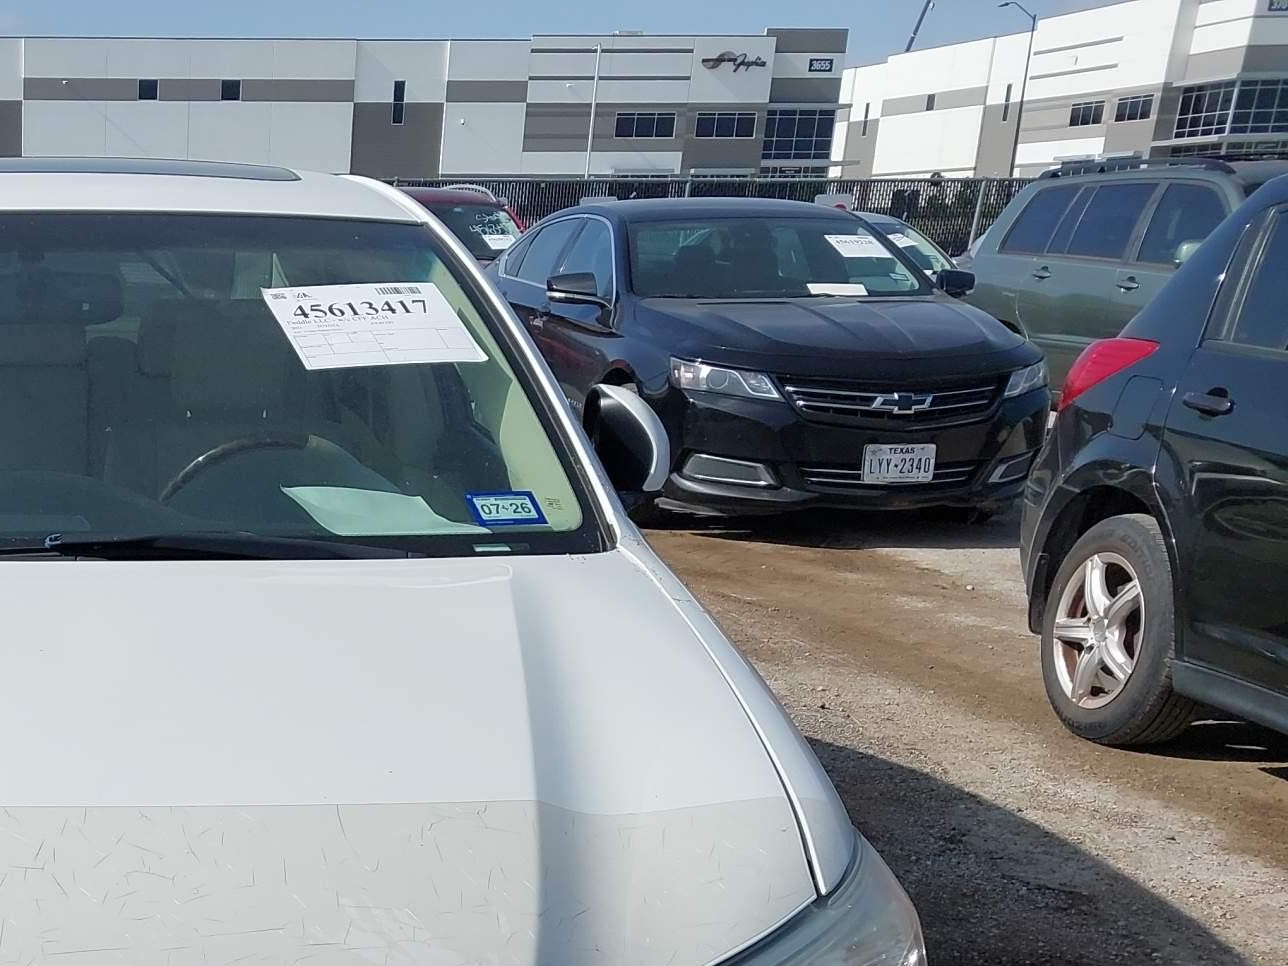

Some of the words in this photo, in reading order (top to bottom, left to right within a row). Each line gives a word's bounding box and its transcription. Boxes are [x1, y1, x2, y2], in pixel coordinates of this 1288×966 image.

[810, 60, 831, 71] 3655
[293, 299, 427, 319] 45613417
[888, 447, 916, 455] TEXAS
[480, 503, 500, 515] 07
[509, 502, 532, 514] 26
